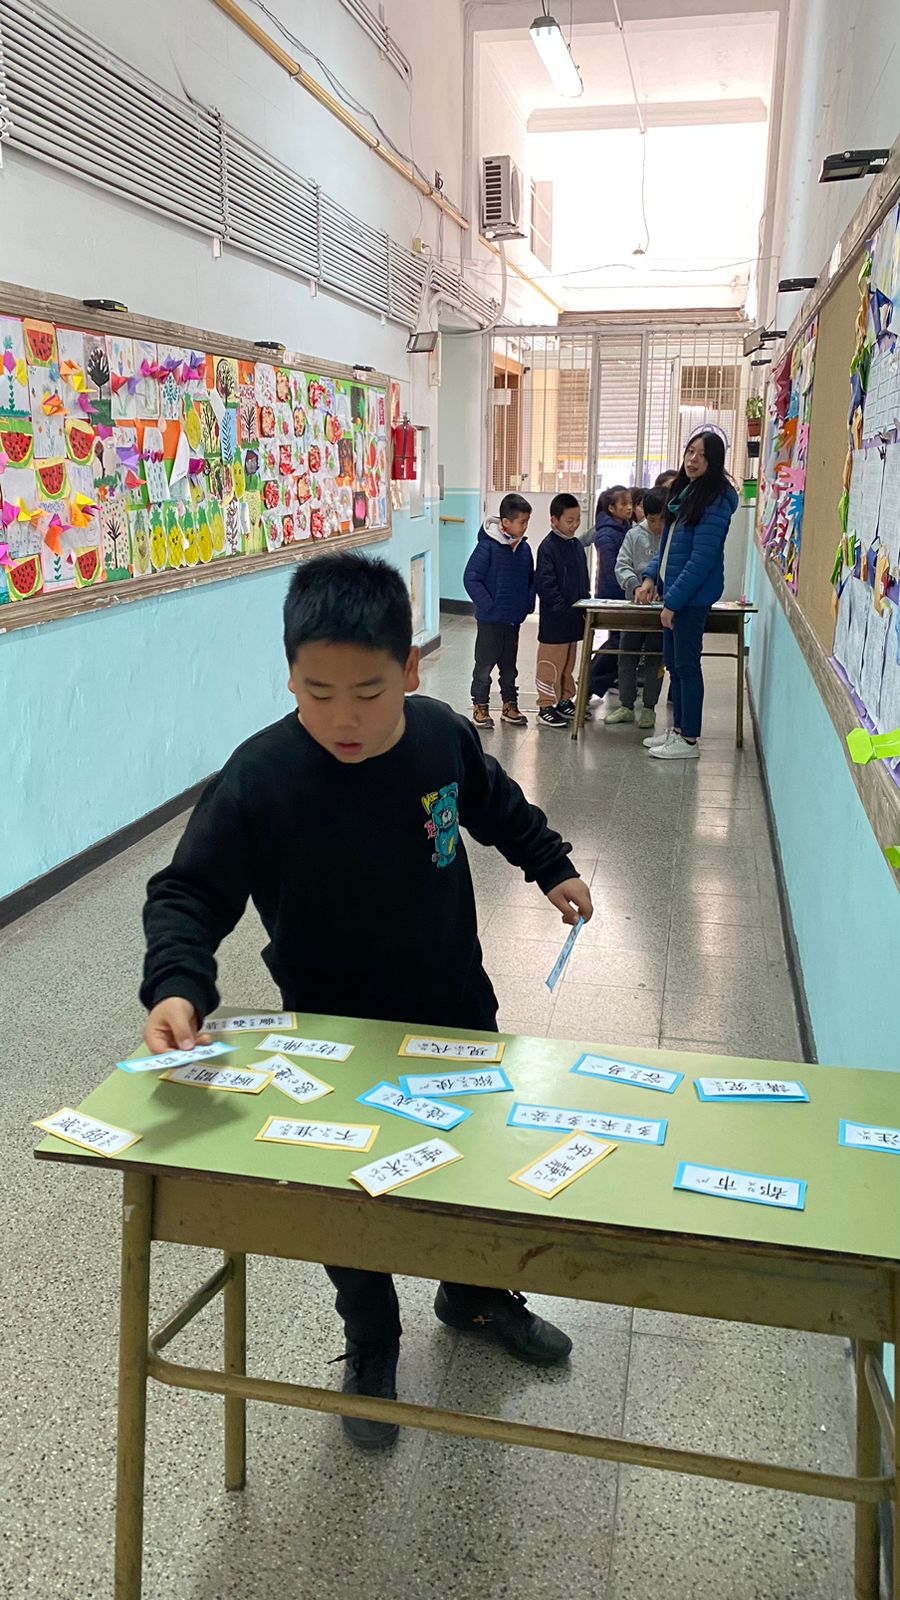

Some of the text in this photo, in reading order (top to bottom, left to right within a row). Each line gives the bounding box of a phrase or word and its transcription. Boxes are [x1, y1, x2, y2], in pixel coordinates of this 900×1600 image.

[417, 1042, 488, 1056] 現代
[590, 1063, 665, 1085] 容易
[696, 1174, 788, 1202] 都市
